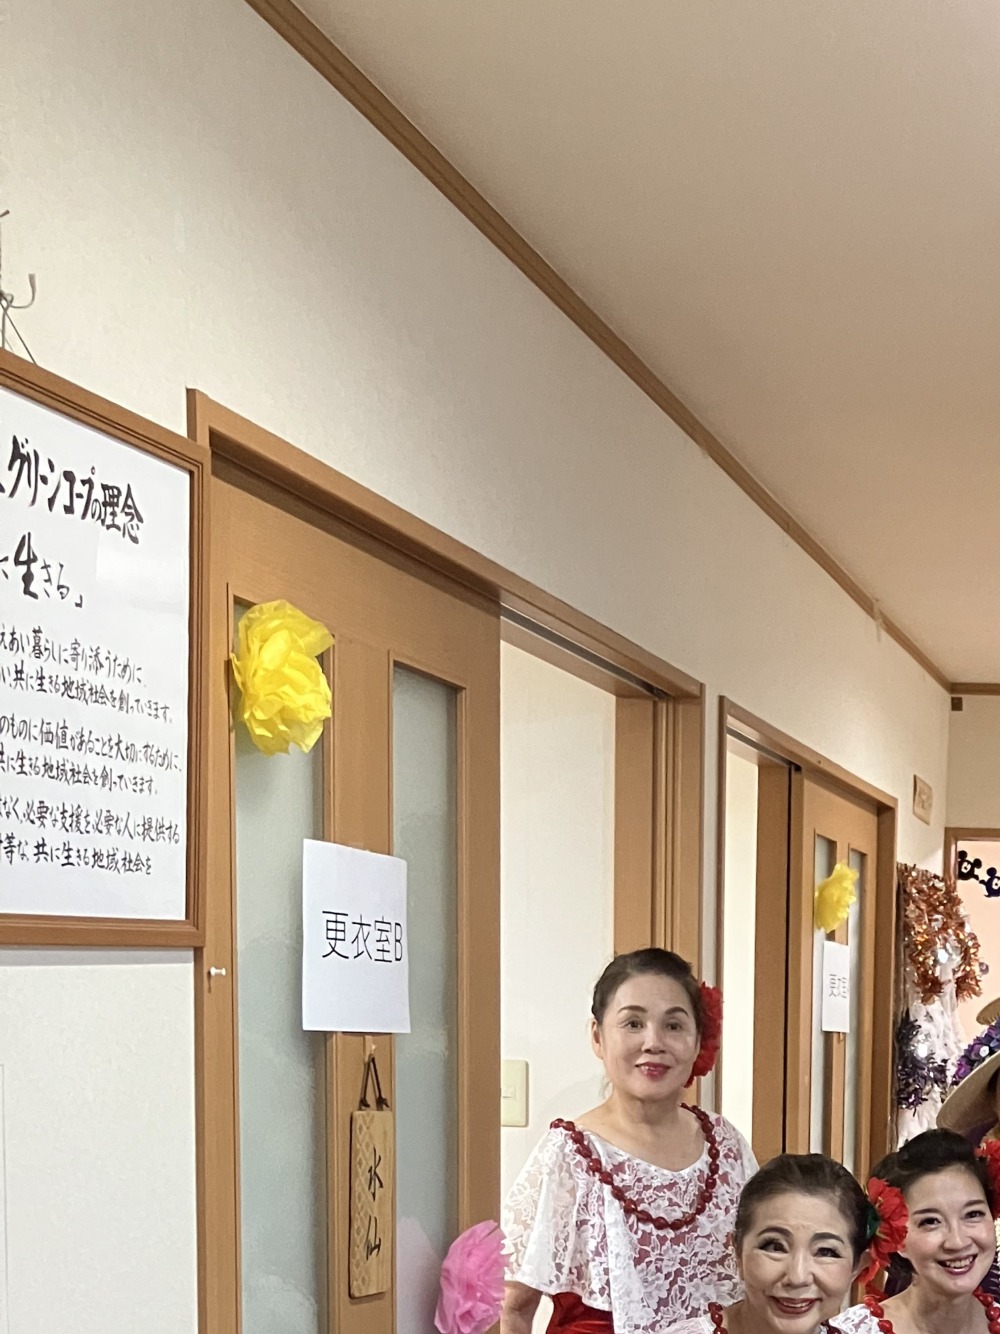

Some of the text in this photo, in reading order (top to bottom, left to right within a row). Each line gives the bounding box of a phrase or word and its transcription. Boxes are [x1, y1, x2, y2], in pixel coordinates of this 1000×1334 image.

[0, 435, 144, 544] グリーンコープの理念
[0, 794, 179, 845] なく、必要な支援を必要な人に提供する
[322, 910, 403, 963] 更衣室B
[364, 1146, 384, 1261] 水仙
